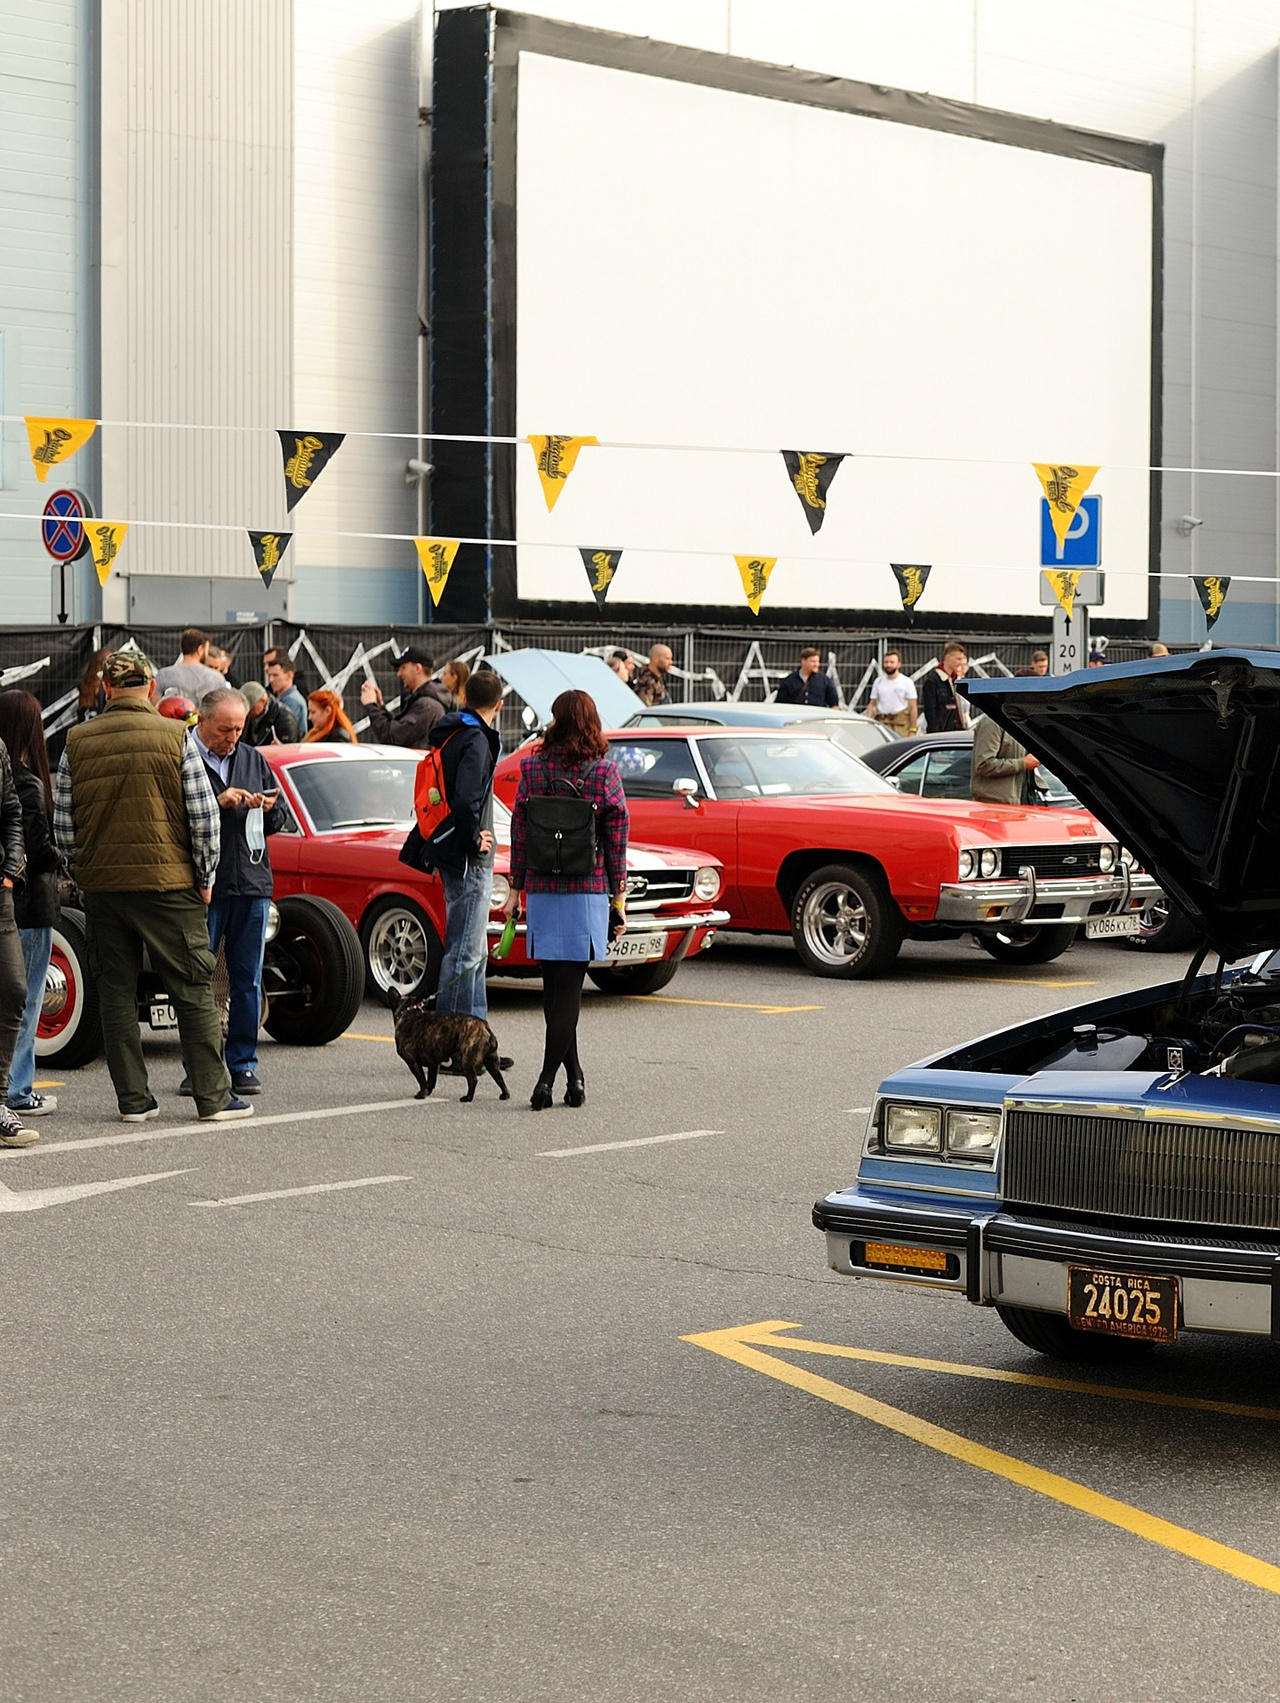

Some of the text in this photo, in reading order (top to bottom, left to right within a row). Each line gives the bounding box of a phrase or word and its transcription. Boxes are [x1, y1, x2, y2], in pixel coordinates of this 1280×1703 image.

[294, 435, 324, 489] Original
[797, 452, 827, 508] Original
[1060, 644, 1076, 658] 20
[1092, 1273, 1151, 1291] COSTA RICA
[1083, 1283, 1161, 1325] 24025
[1110, 1321, 1147, 1336] AMERICA
